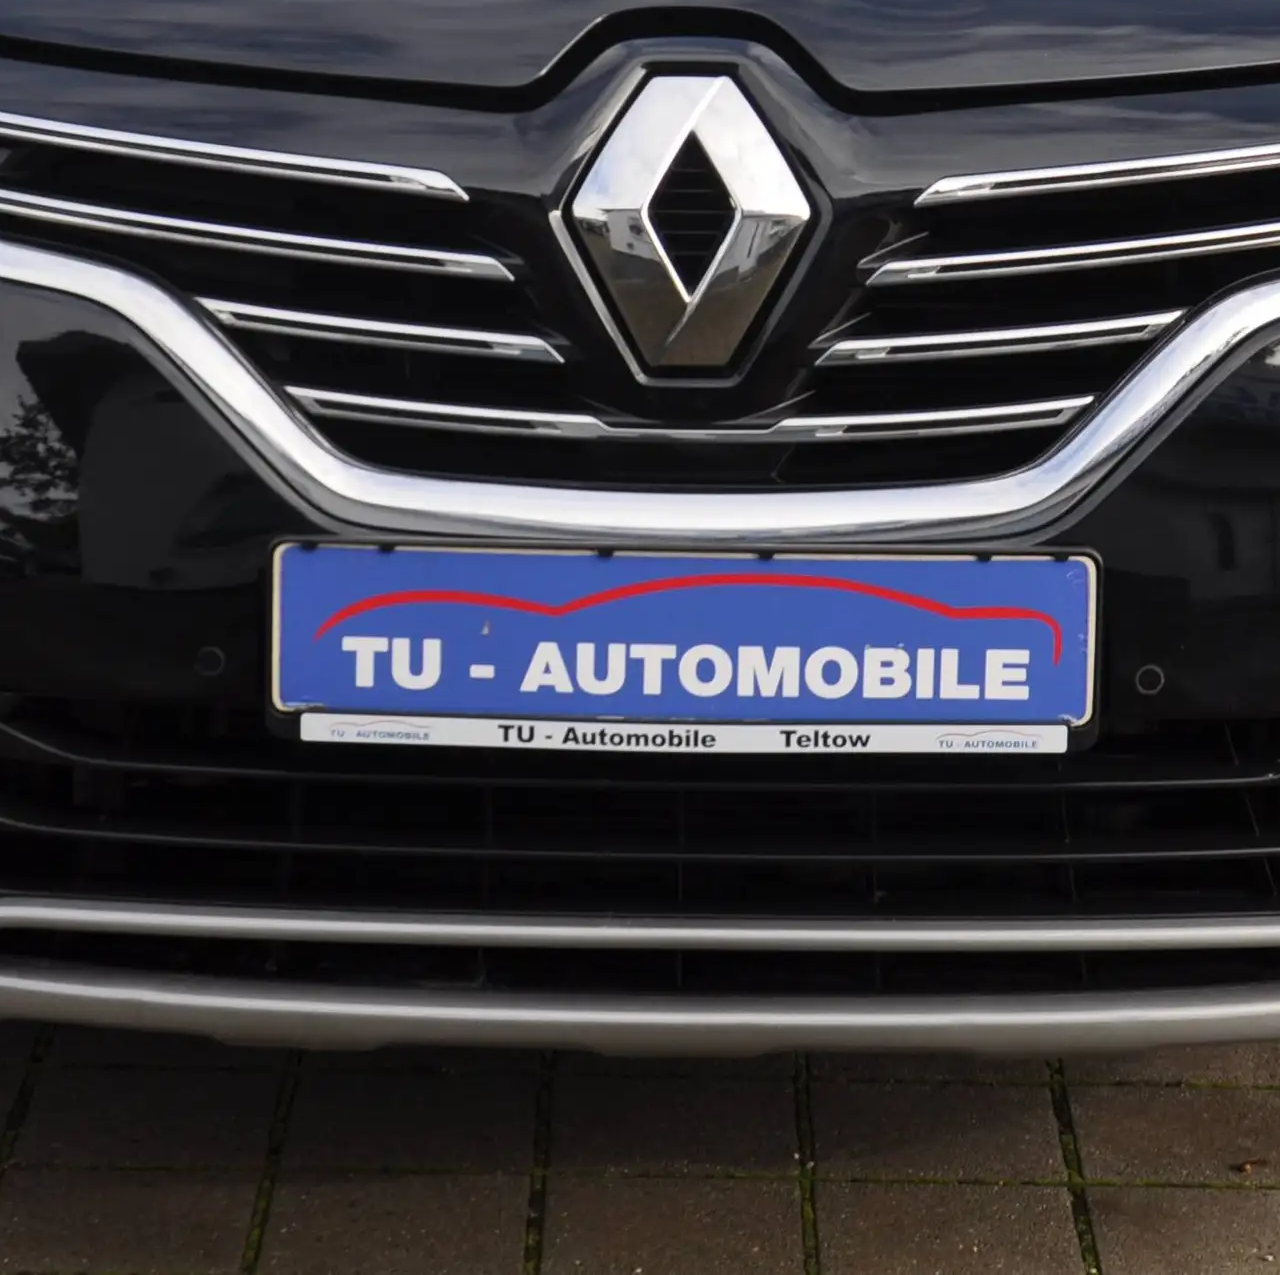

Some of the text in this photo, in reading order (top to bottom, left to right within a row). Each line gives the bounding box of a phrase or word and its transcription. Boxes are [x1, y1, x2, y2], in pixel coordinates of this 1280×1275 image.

[342, 636, 1030, 701] TU - AUTOMOBILE
[356, 730, 430, 741] AUTOMOBILE
[497, 724, 535, 743] TU
[561, 727, 717, 748] Automobile
[779, 730, 871, 748] Teltow
[939, 740, 1038, 750] TU AUTOMOBILE
